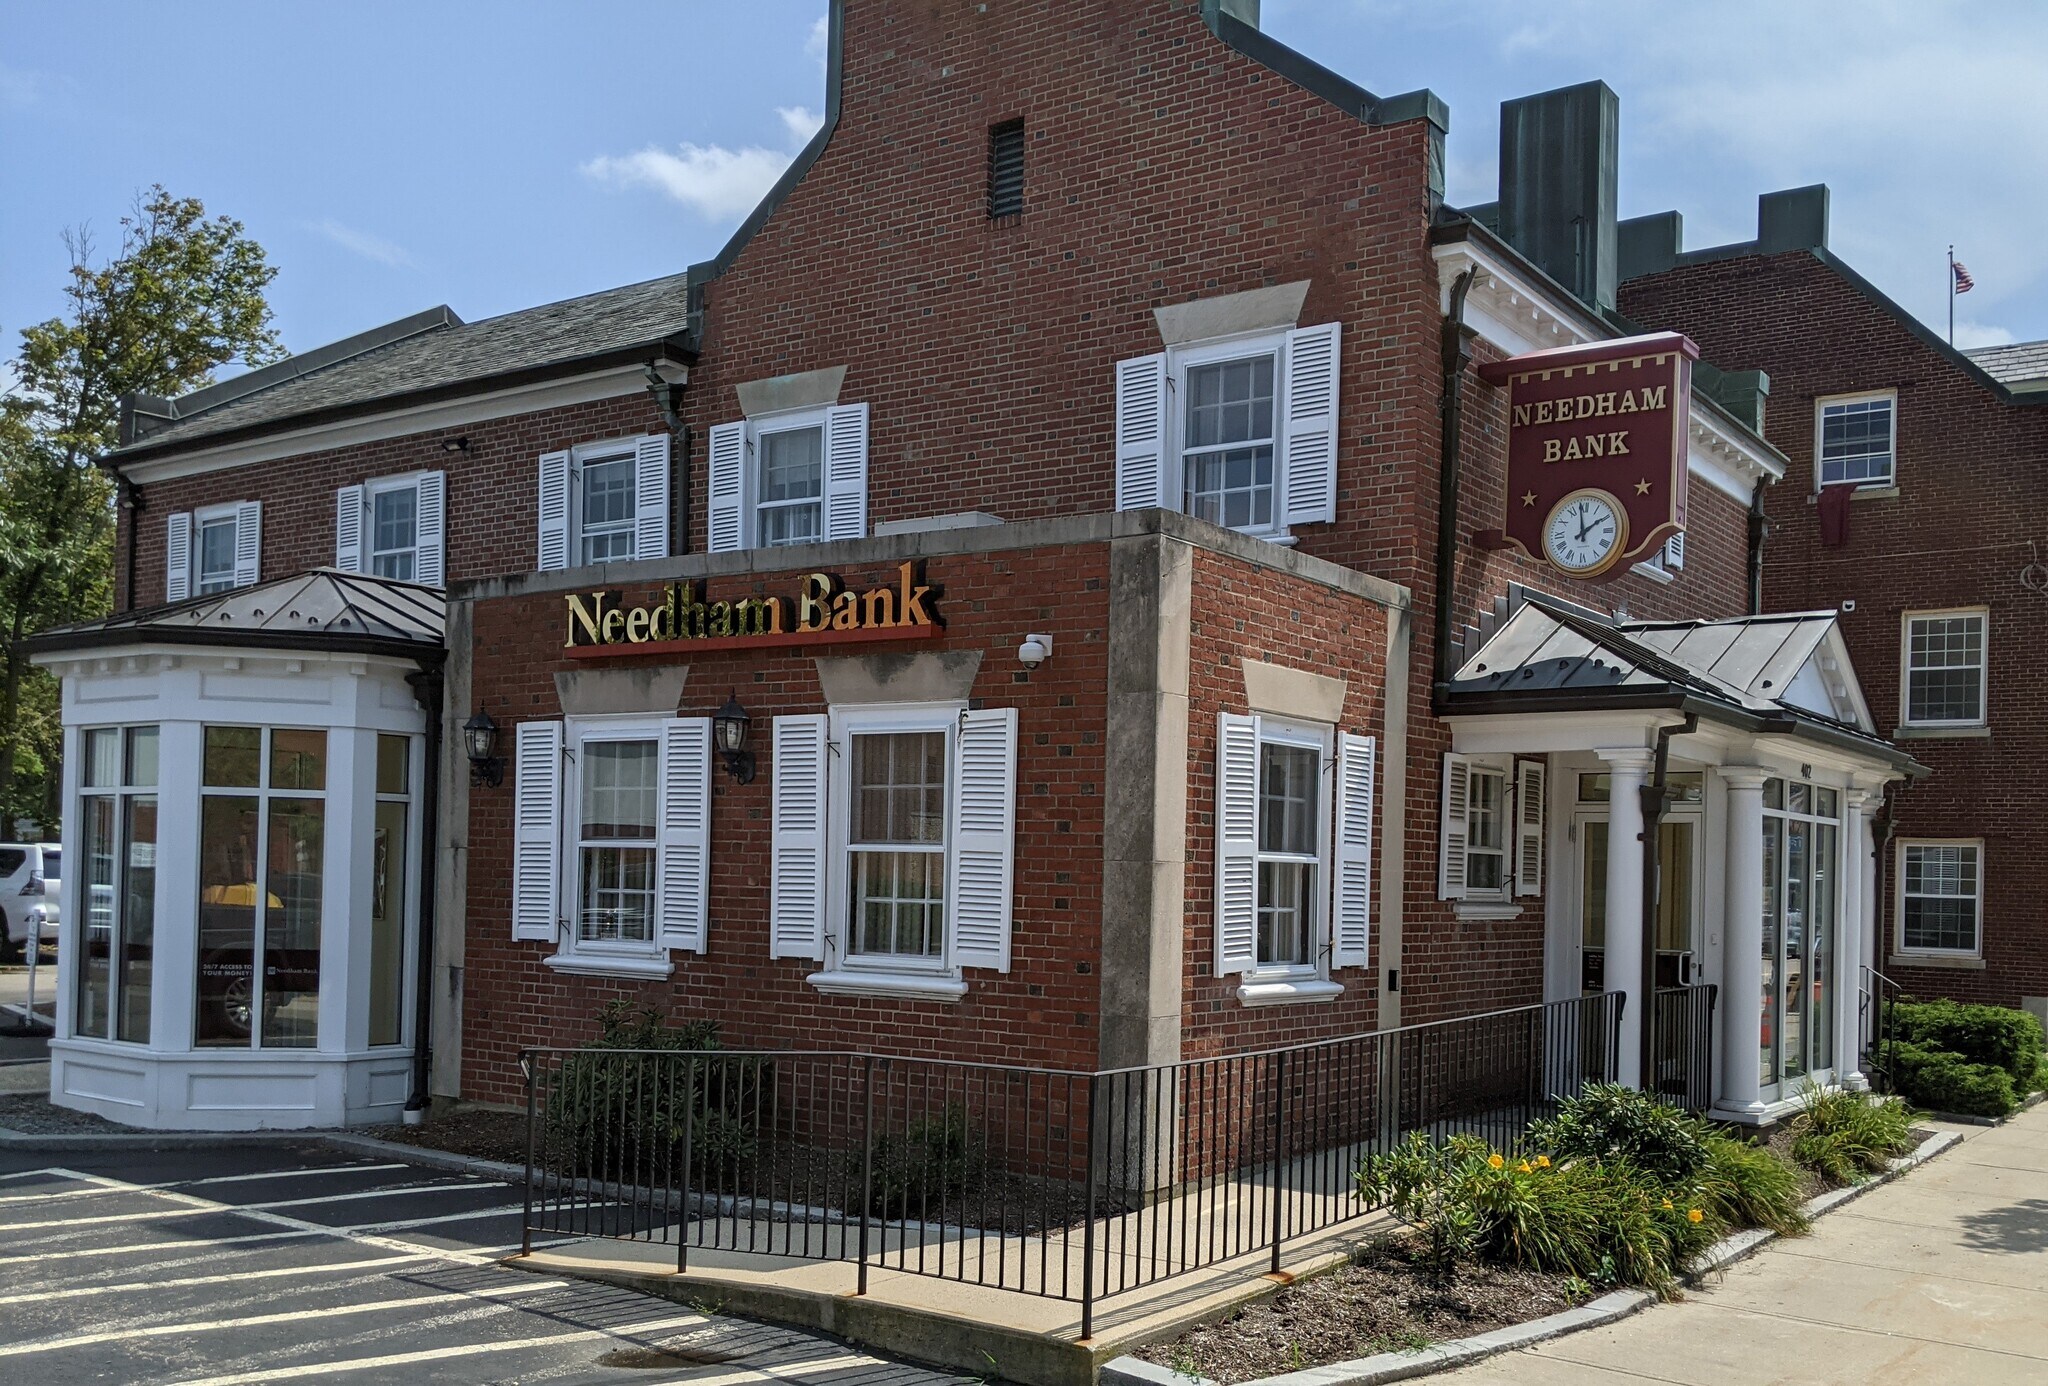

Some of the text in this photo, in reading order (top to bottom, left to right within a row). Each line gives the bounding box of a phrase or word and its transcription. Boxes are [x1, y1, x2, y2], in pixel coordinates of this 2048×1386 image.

[1512, 385, 1667, 427] NEEDHAM
[1543, 430, 1630, 463] BANK
[564, 561, 932, 648] Needham Bank
[1801, 762, 1812, 779] 402
